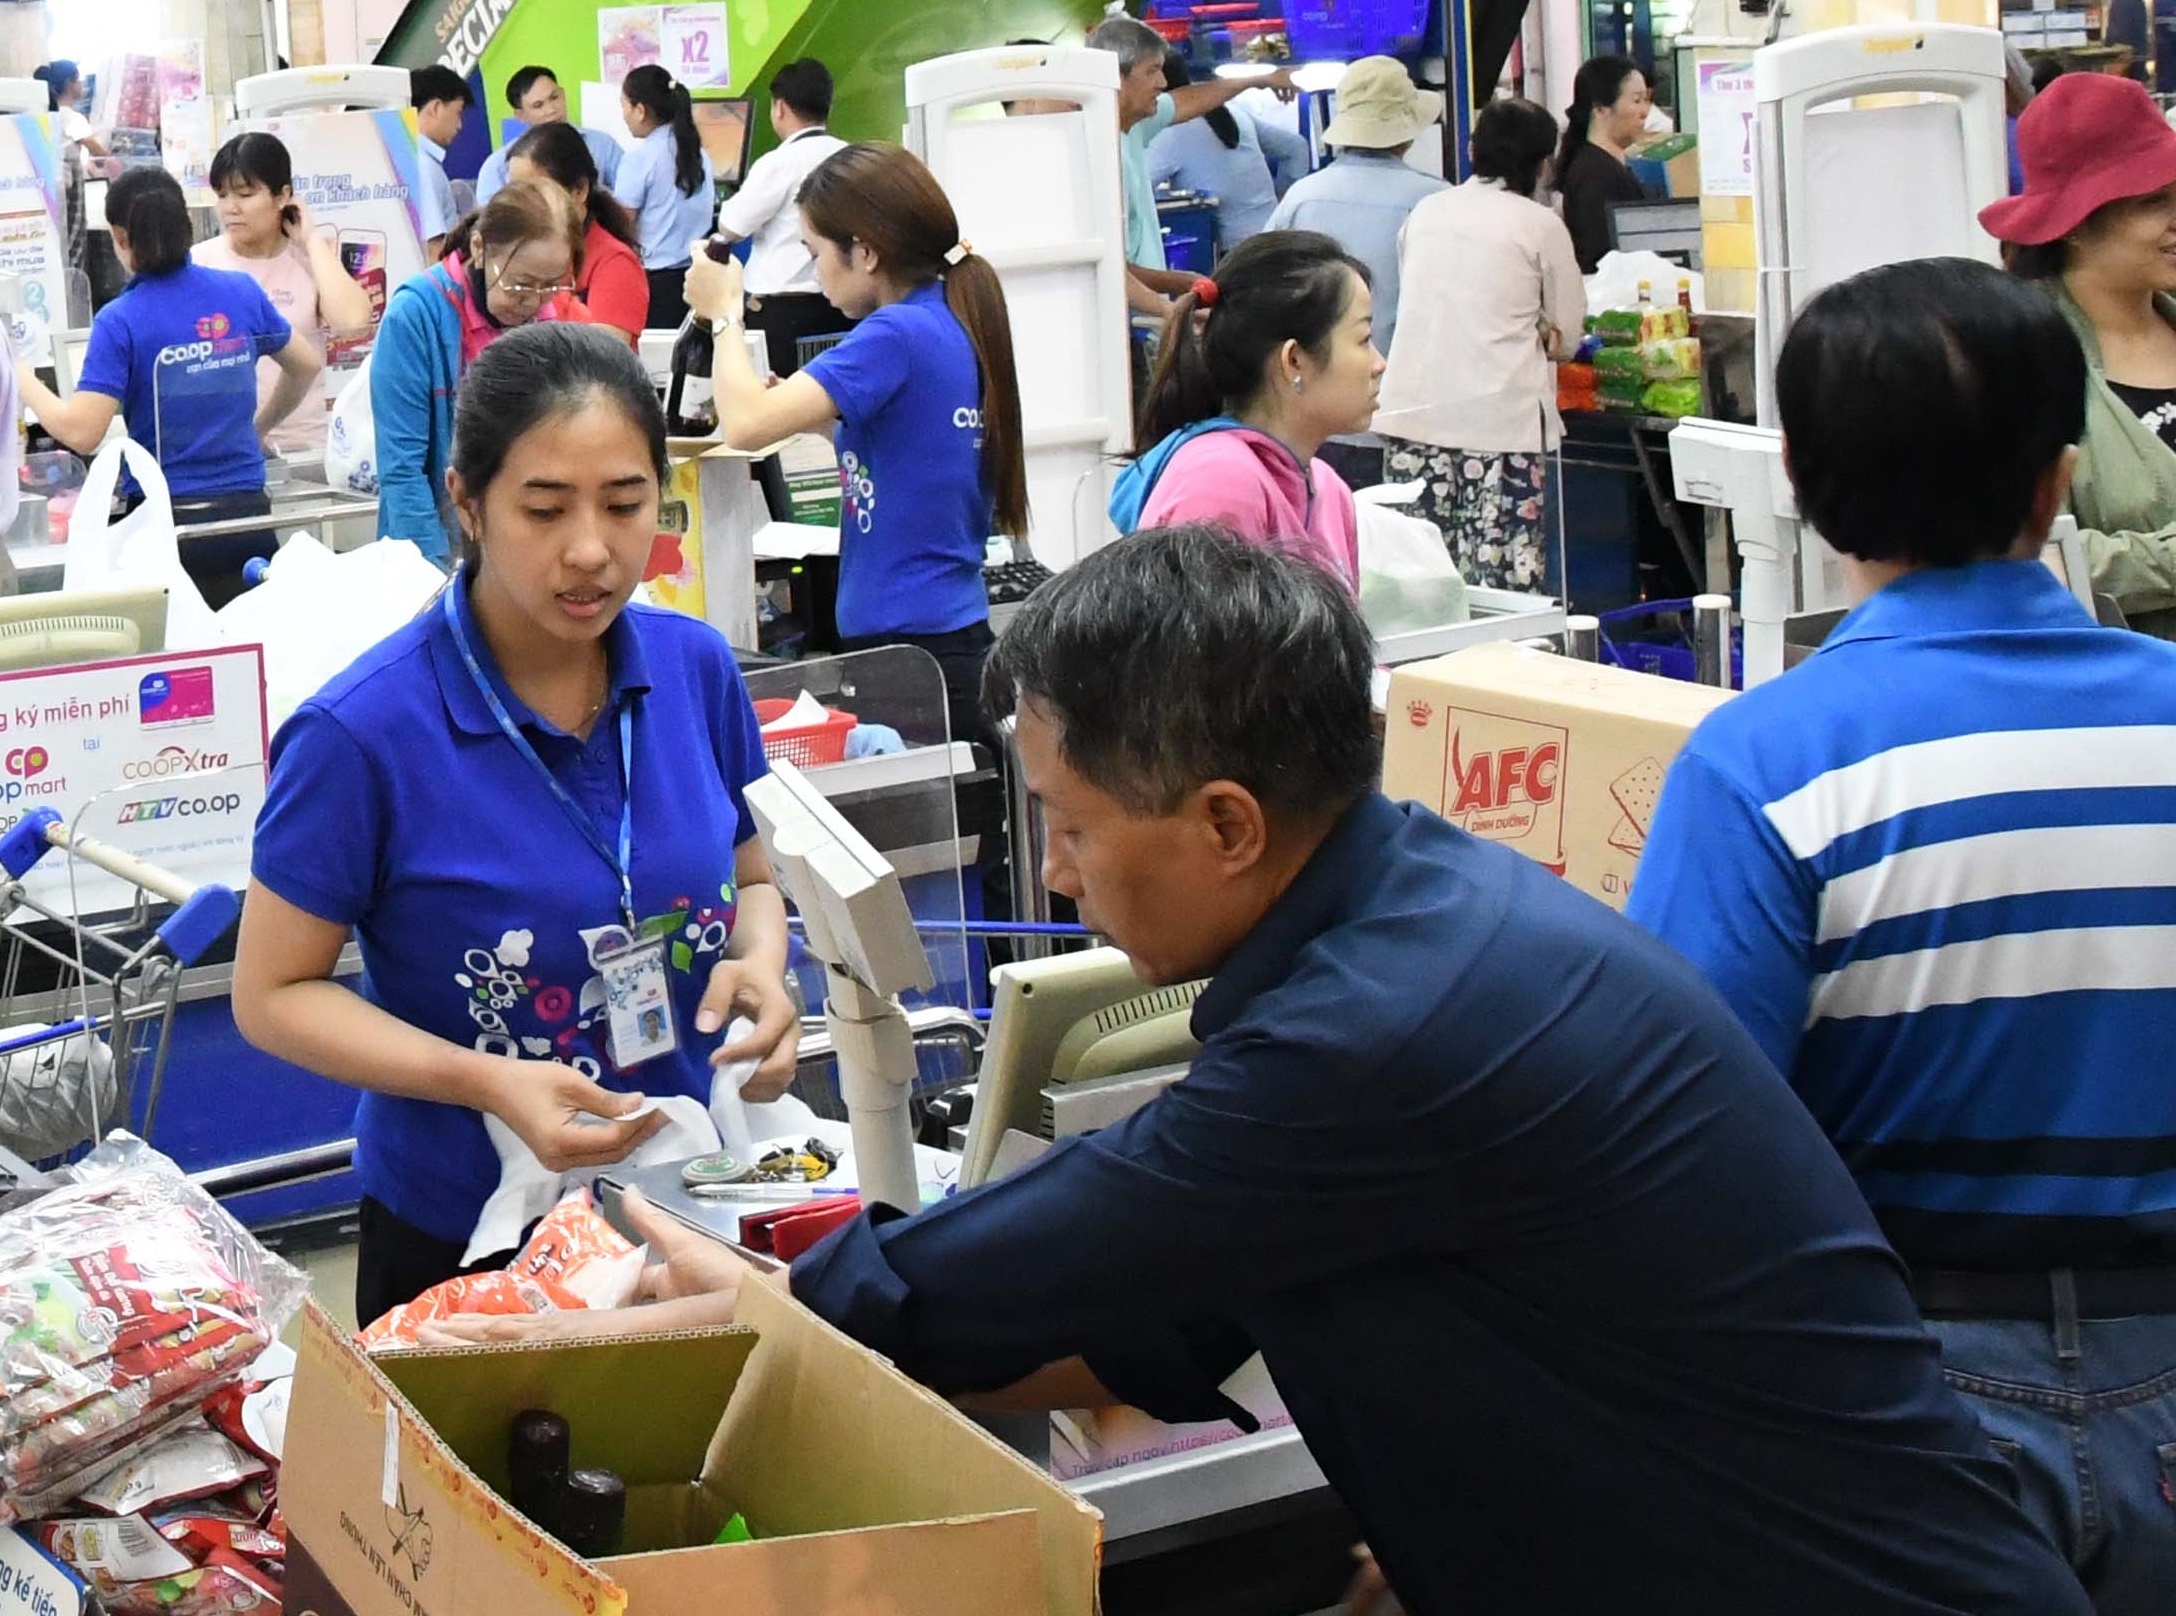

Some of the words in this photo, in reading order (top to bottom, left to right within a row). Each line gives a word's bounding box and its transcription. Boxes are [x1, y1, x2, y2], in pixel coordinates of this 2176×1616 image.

[16, 704, 38, 728] ký
[45, 696, 92, 723] miễn
[99, 694, 130, 720] phí
[1452, 742, 1558, 813] AFC
[13, 1568, 35, 1602] kế
